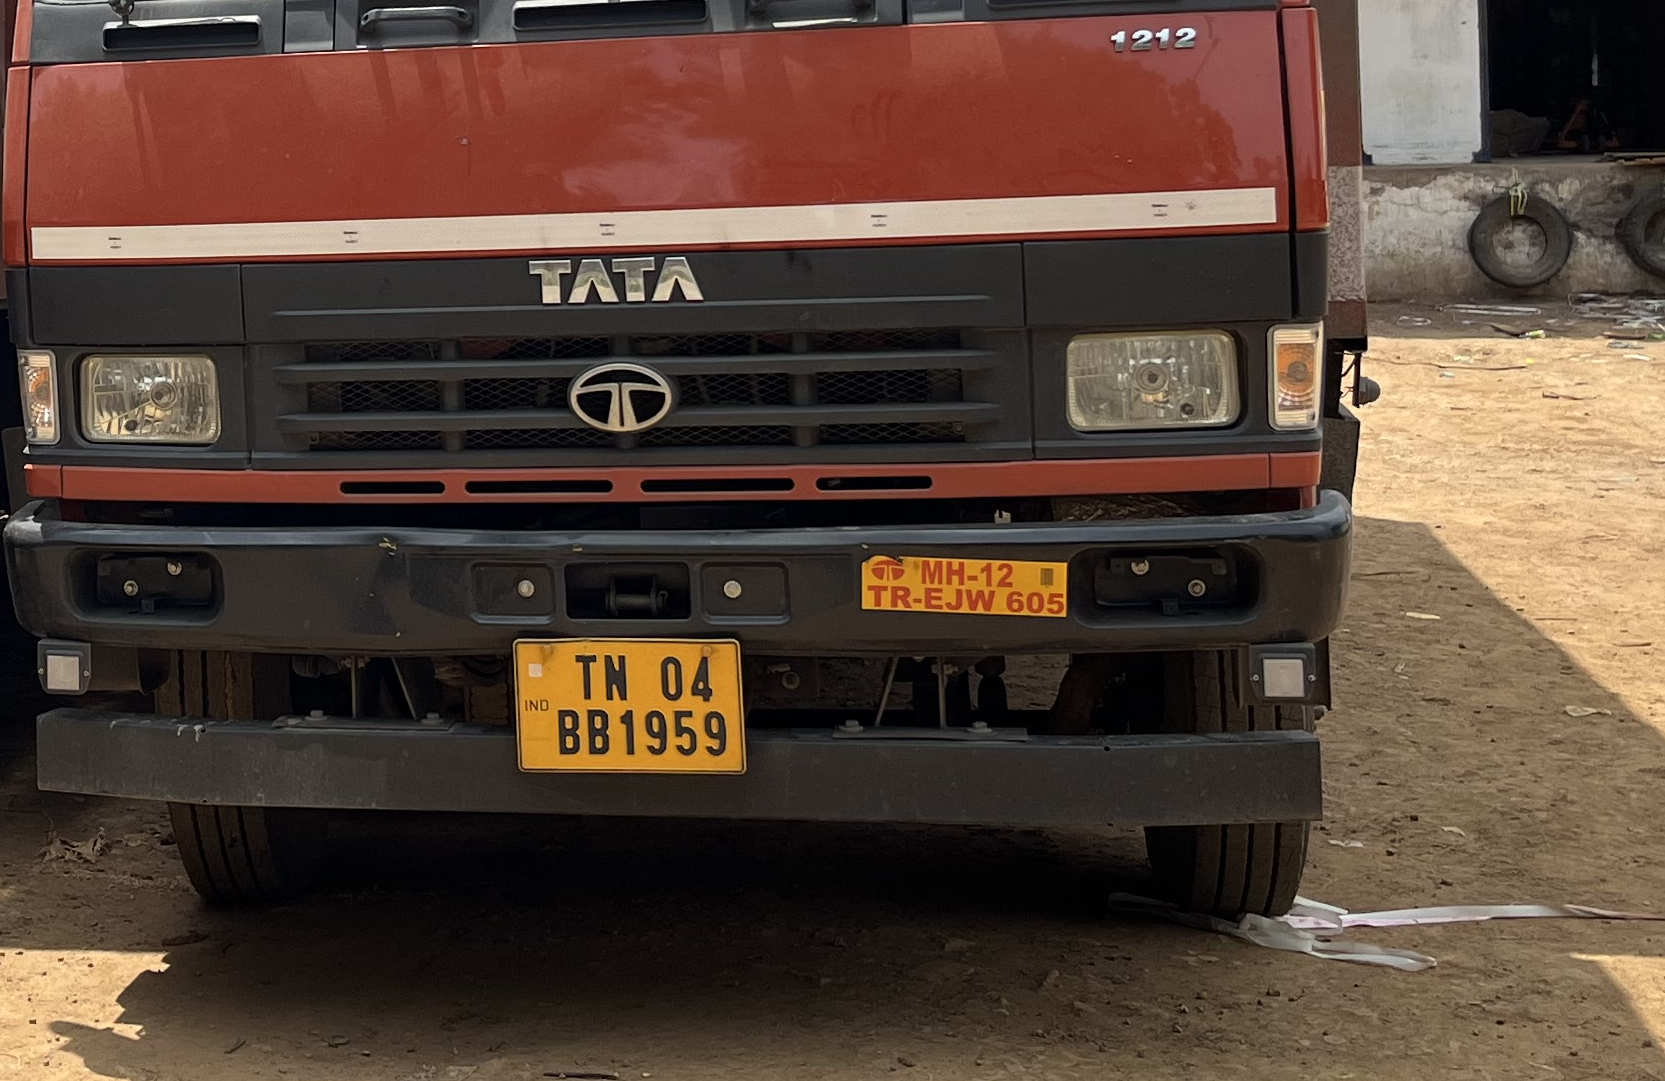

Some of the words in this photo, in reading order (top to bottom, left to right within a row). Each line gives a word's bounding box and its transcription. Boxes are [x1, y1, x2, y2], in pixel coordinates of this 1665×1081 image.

[1110, 27, 1197, 52] 1212
[528, 256, 704, 304] TATA
[920, 559, 1014, 588] MH-12
[867, 585, 996, 613] TR-EJW
[1005, 590, 1065, 615] 605
[575, 654, 628, 702] TN
[660, 655, 713, 702] 04
[524, 699, 549, 712] IND
[557, 709, 727, 757] BB1959
